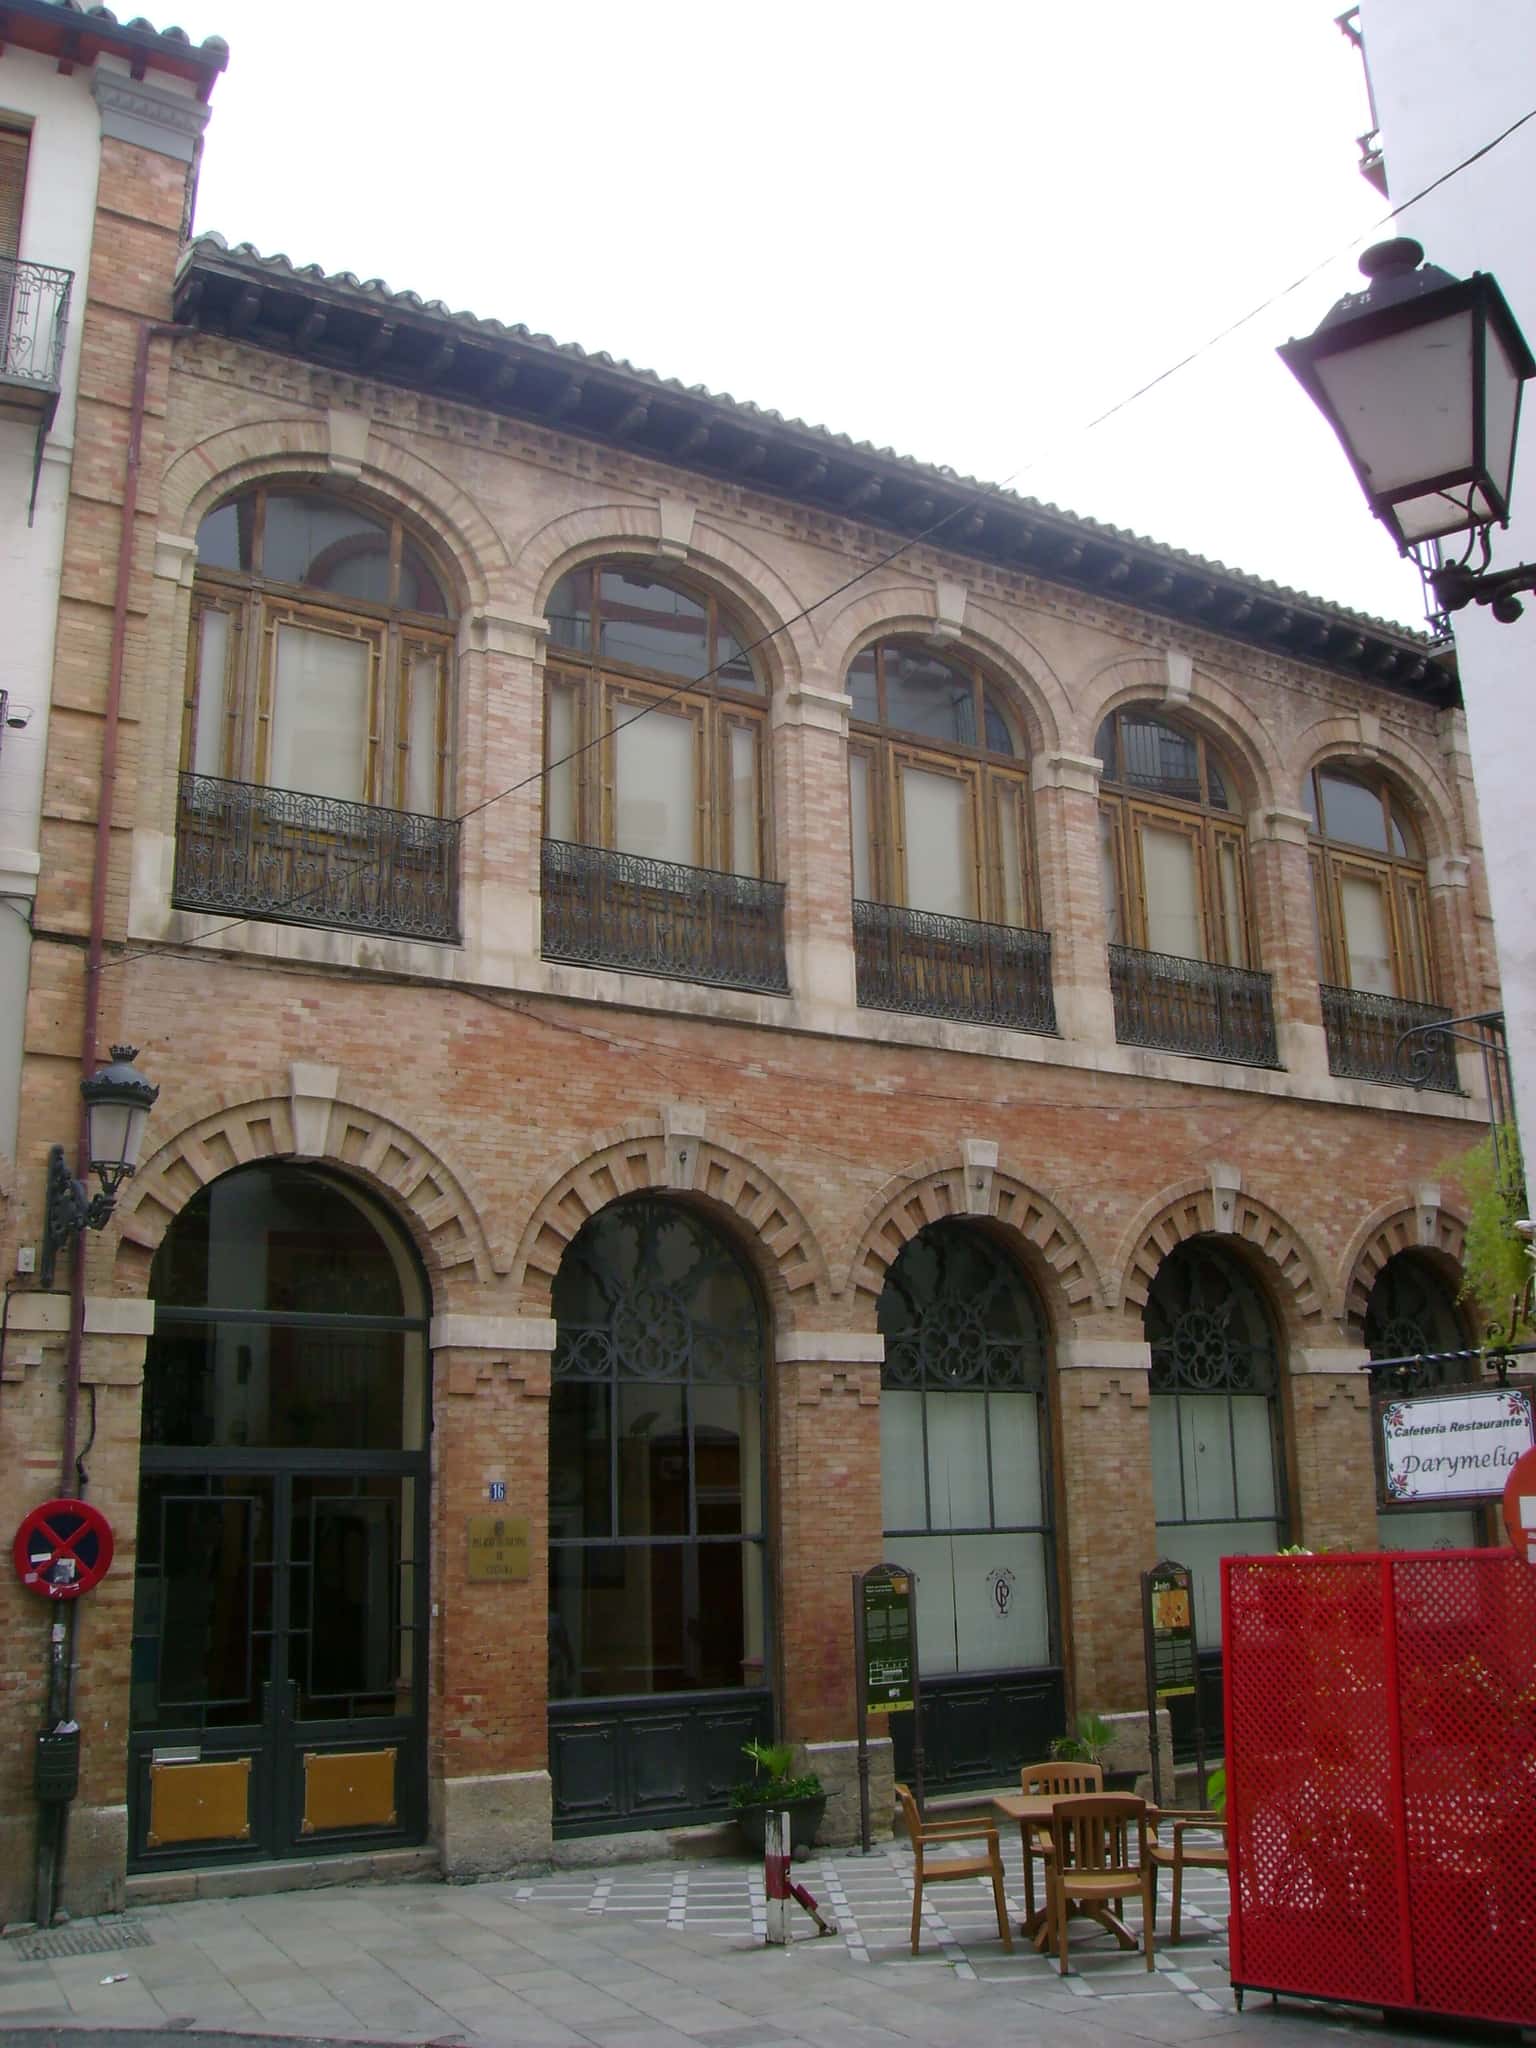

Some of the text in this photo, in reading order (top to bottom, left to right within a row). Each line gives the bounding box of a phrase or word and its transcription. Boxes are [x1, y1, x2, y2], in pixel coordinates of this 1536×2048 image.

[1449, 1417, 1523, 1433] Restaurante
[1401, 1445, 1520, 1478] Darymelia
[492, 1483, 504, 1500] 16
